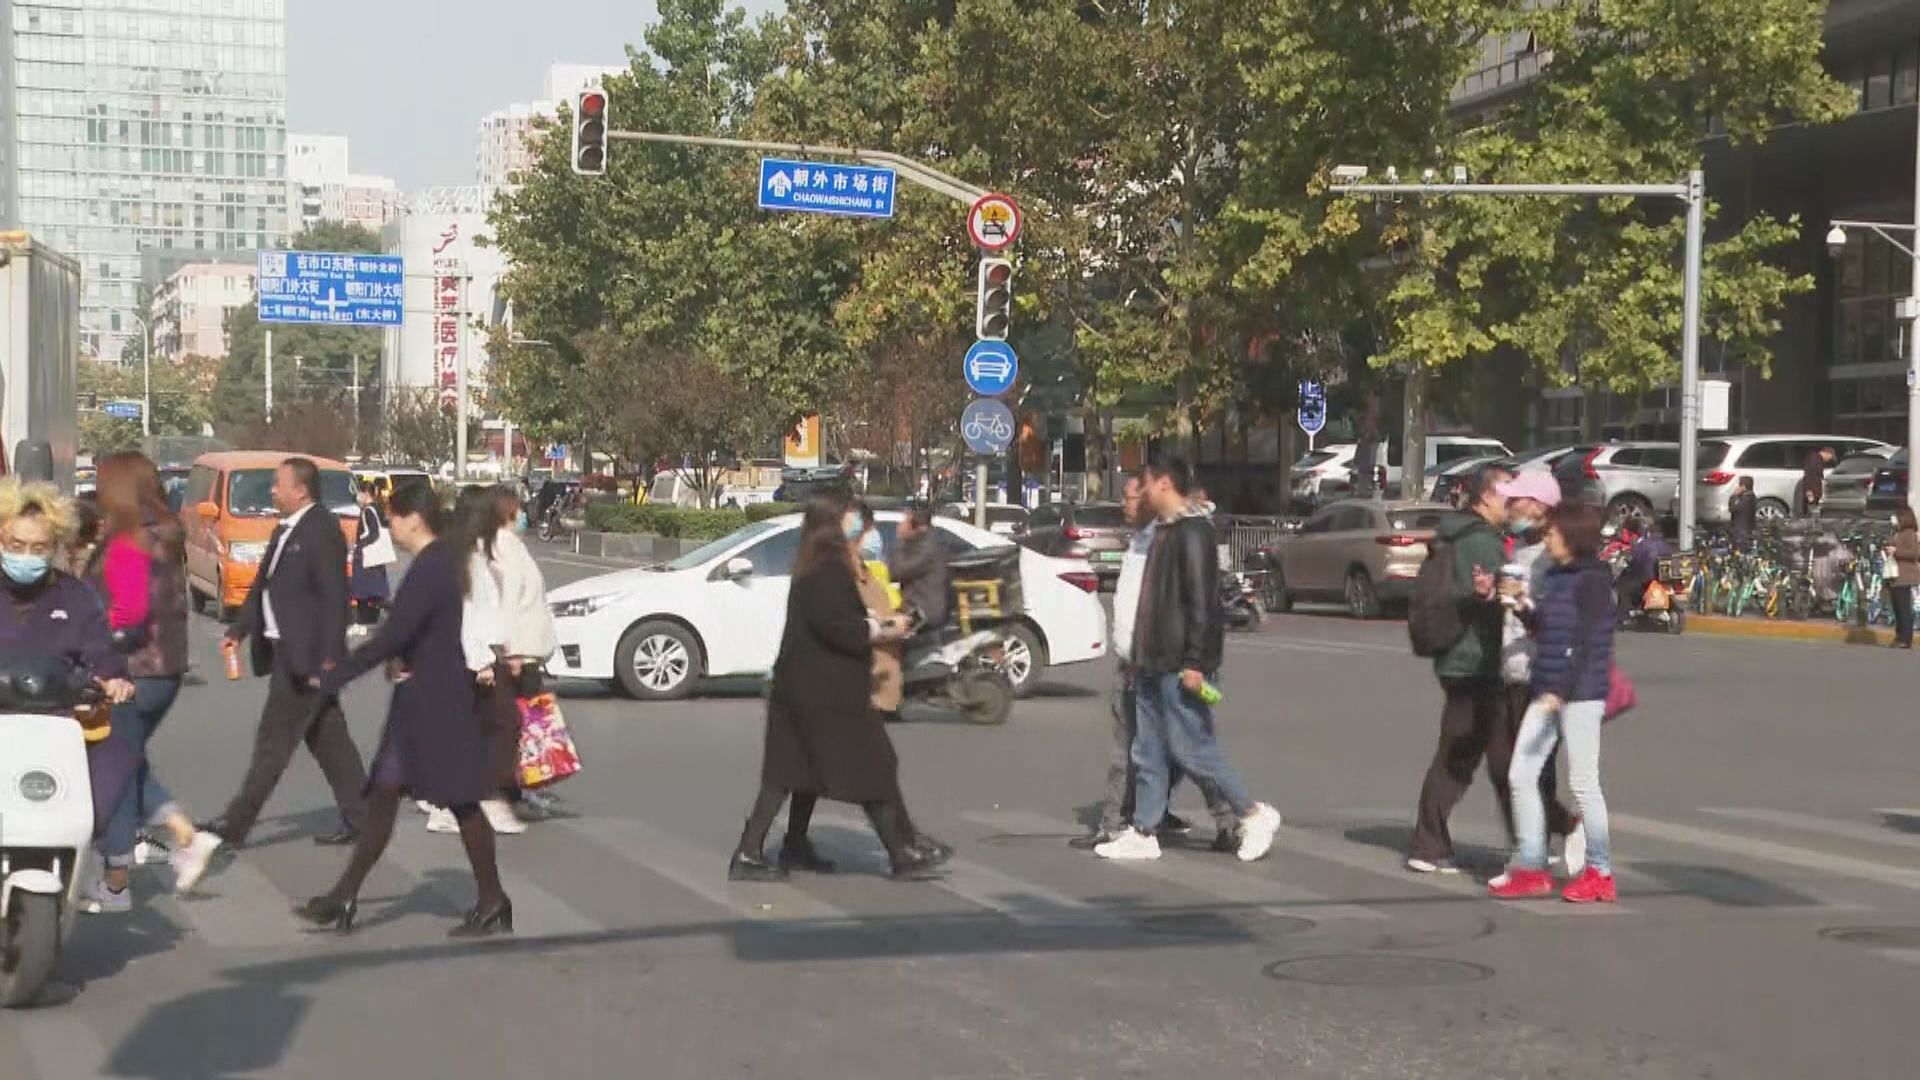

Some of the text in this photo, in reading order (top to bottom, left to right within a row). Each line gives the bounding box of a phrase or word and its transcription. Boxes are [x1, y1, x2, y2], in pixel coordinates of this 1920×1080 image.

[793, 168, 888, 194] 朝外市场街
[793, 192, 872, 208] CHAOWAISHICHANG
